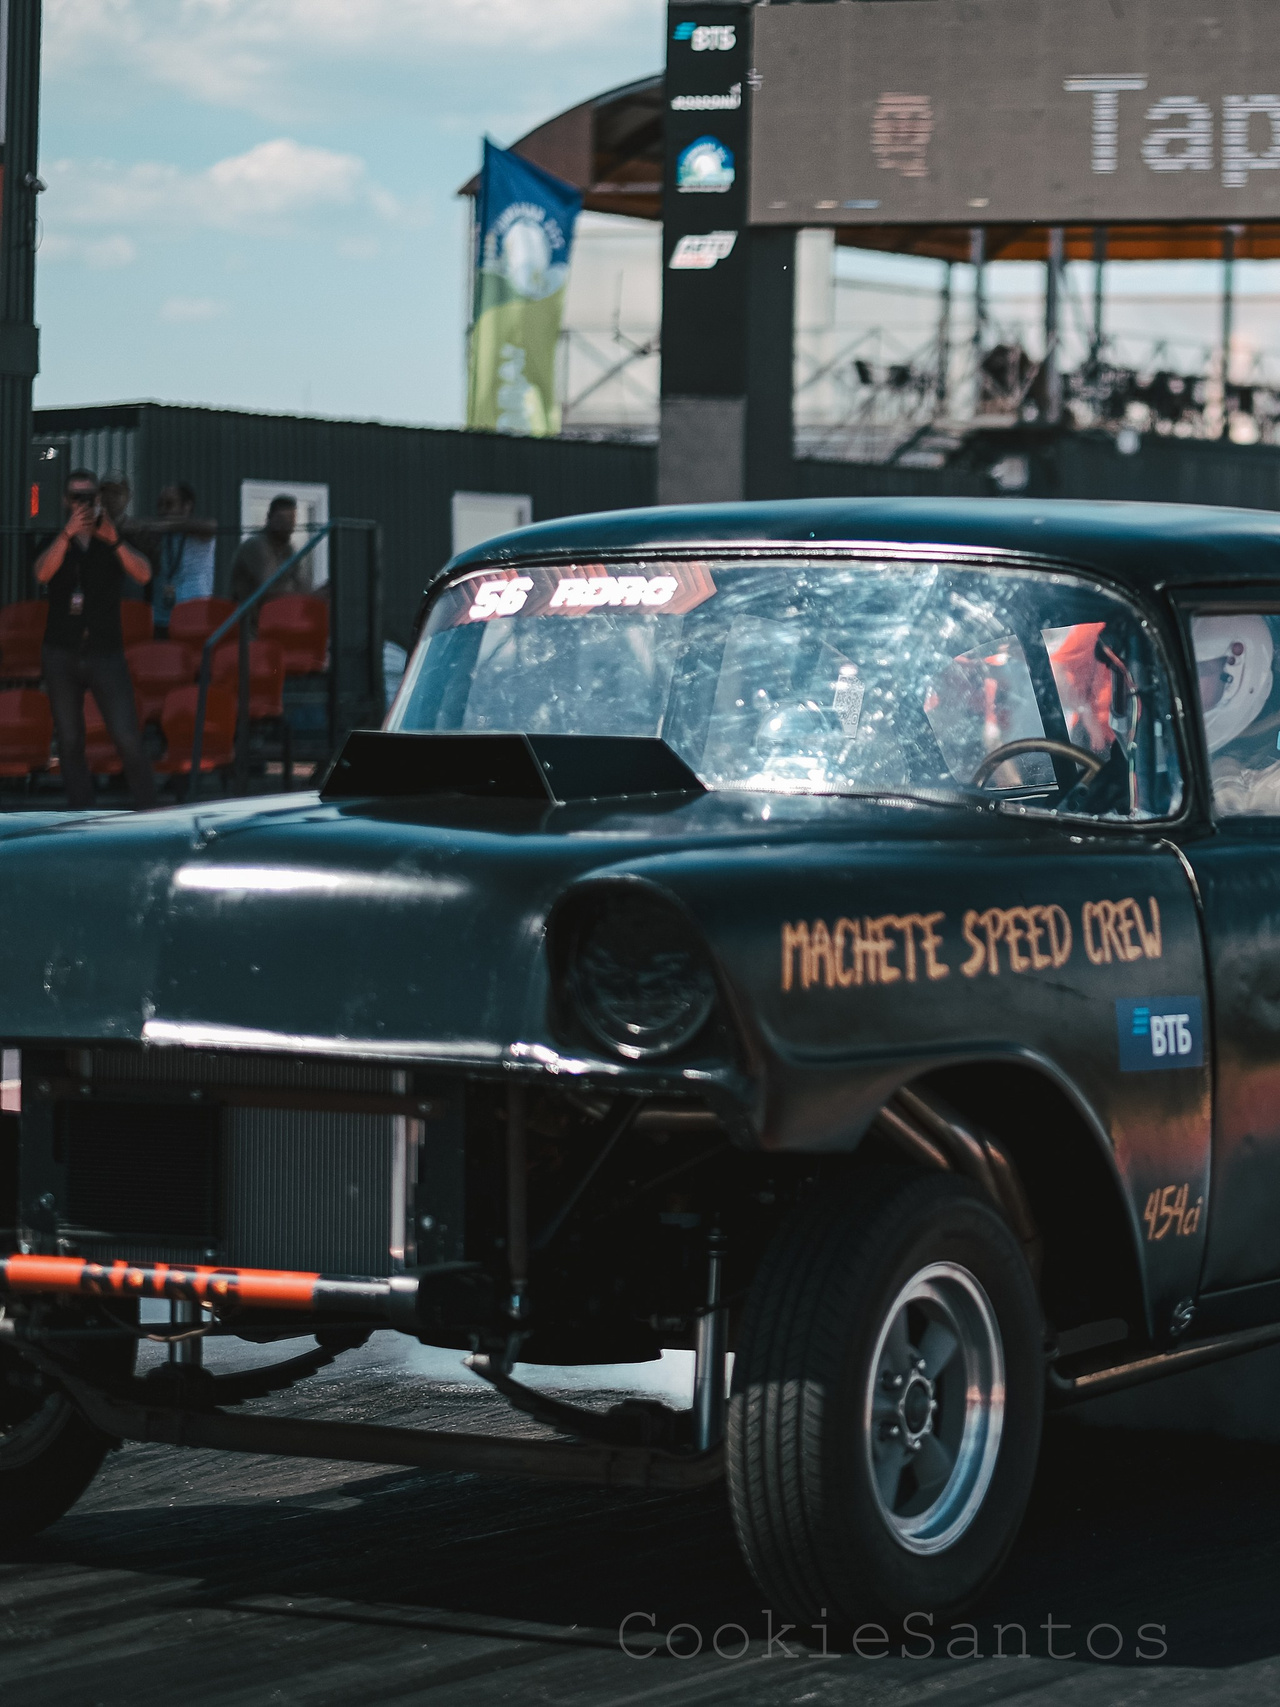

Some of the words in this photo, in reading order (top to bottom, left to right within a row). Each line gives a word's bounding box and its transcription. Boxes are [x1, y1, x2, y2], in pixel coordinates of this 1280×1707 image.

[469, 576, 534, 621] 56
[550, 576, 679, 607] RDRC
[780, 912, 949, 993] MACHETE
[961, 905, 1072, 978] SPEED
[1082, 896, 1162, 965] CREW
[1150, 1013, 1193, 1056] ВТБ
